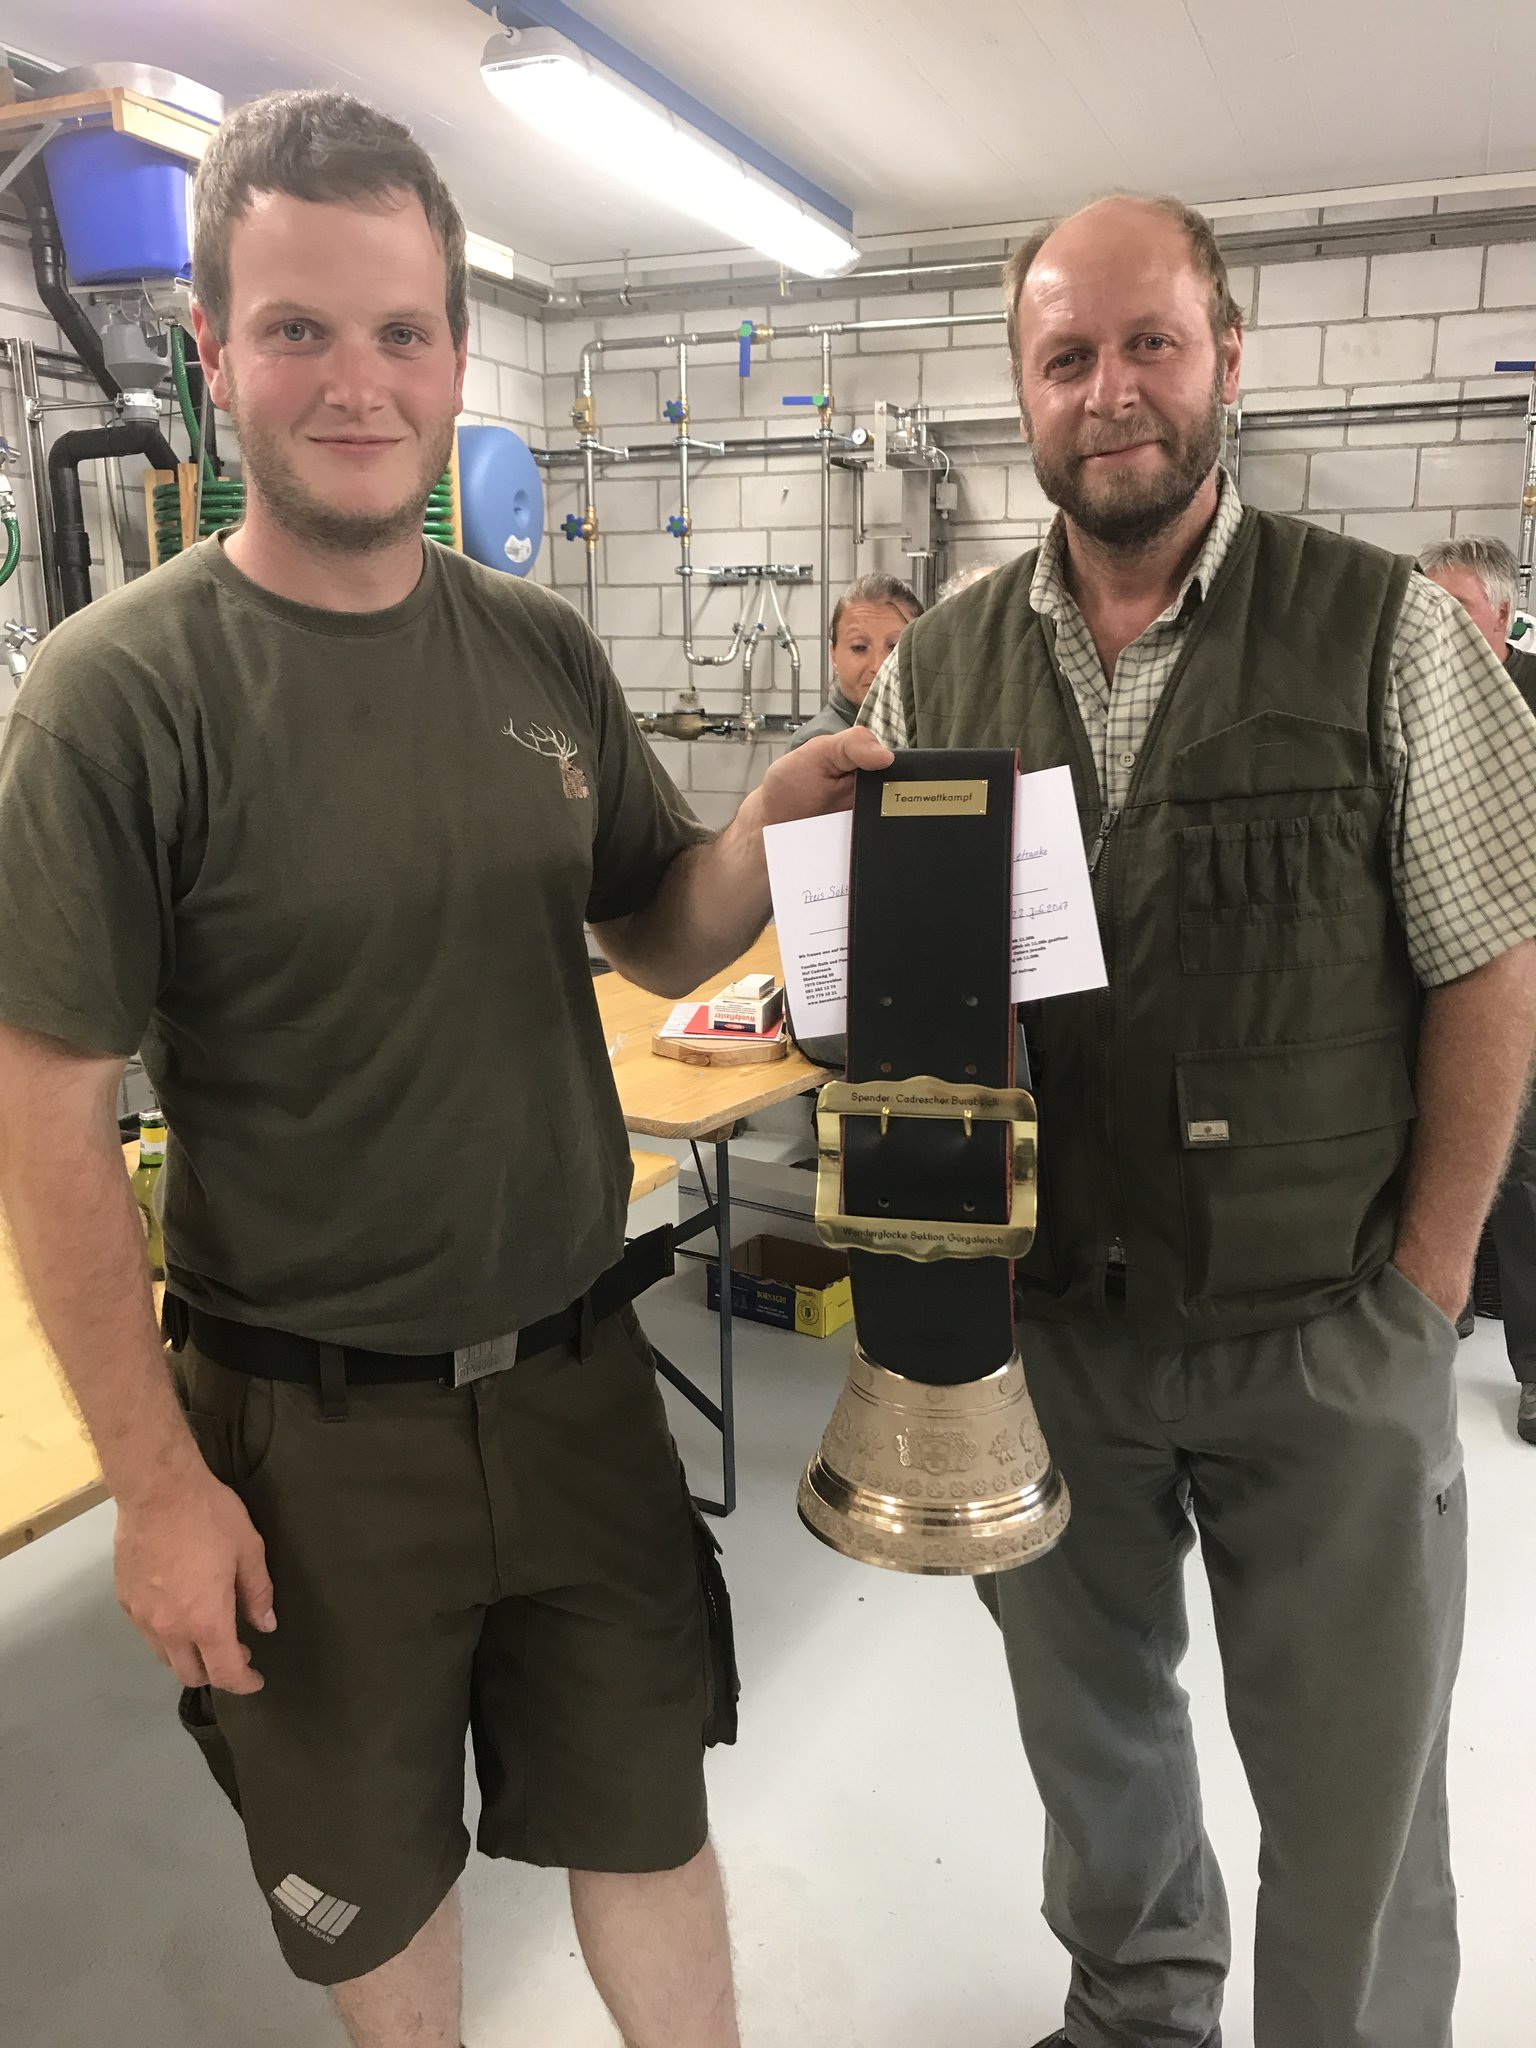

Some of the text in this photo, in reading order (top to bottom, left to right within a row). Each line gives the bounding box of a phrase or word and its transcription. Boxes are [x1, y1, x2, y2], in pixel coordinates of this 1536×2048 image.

[894, 793, 972, 802] Teamwettkampf
[802, 887, 825, 903] Preis
[715, 1013, 755, 1023] Wundpflaster
[896, 1093, 949, 1104] Cadrescher
[842, 1227, 1004, 1246] Wanderglocke Sektion Gürgaletsch
[307, 1925, 336, 1945] WIELAND
